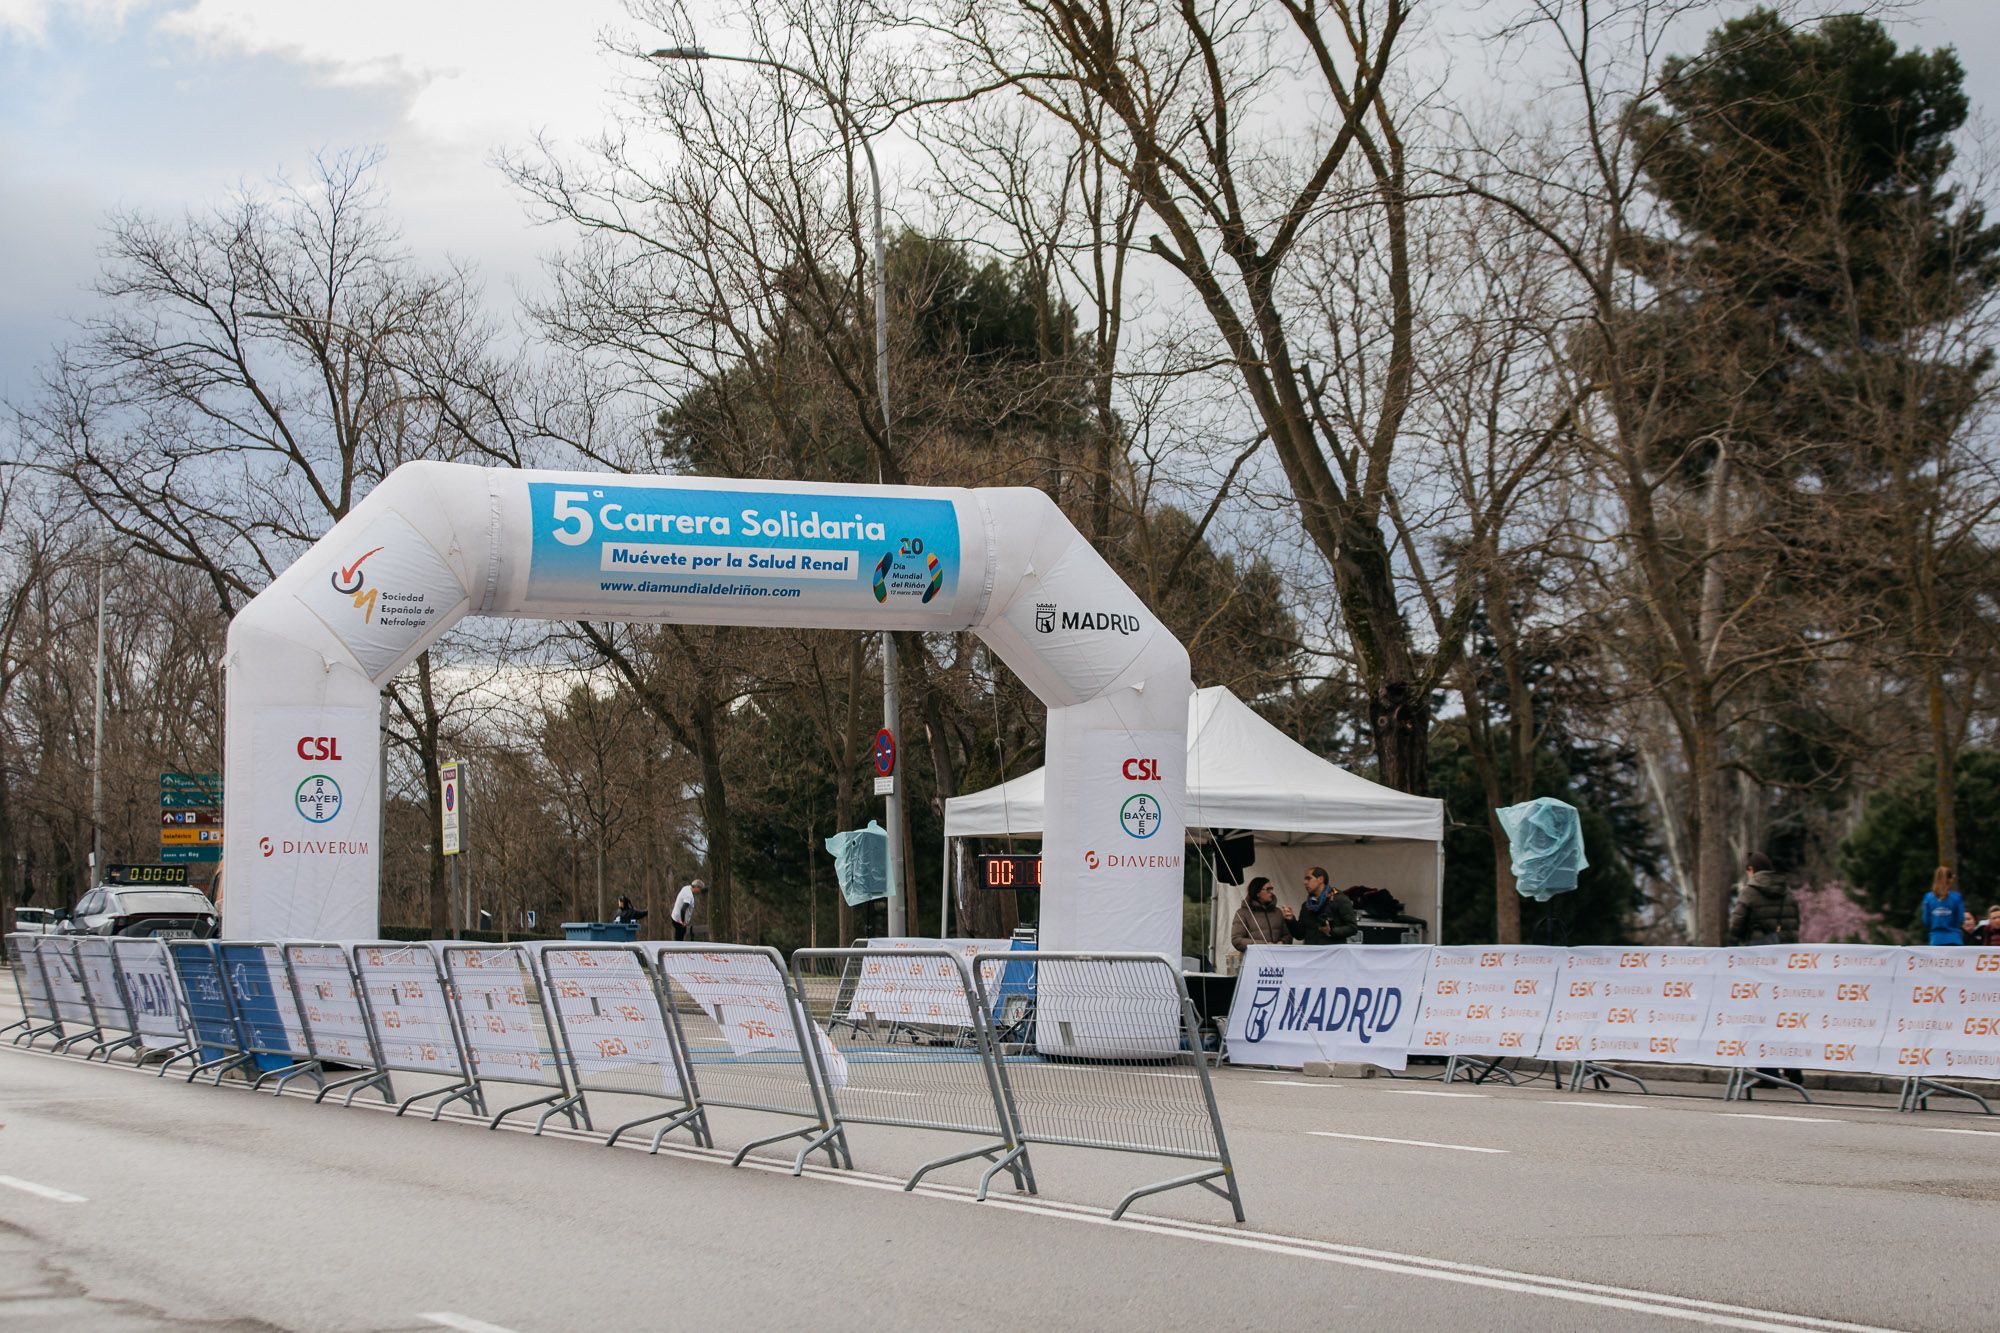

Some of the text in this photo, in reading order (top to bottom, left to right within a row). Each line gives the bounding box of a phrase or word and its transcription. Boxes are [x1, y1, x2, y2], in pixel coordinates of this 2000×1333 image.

[600, 503, 730, 535] Carrera
[741, 510, 886, 541] Solidaria
[900, 537, 924, 555] 20
[612, 549, 848, 572] Muévete por la Salud Renal
[893, 562, 906, 570] Día
[892, 572, 923, 580] Mundial
[600, 581, 801, 598] www.diamundialdelriñon.com
[904, 581, 926, 589] Riñón
[382, 592, 425, 602] Sociedad
[381, 605, 435, 615] Española de
[1062, 611, 1140, 635] MADRID
[297, 736, 342, 761] CSL
[1122, 758, 1161, 781] CSL
[300, 795, 339, 803] BAYER
[316, 779, 324, 819] BAYER
[1124, 812, 1158, 820] BAYER
[1138, 797, 1146, 835] BAYER
[283, 840, 369, 855] DIAVERUM
[1108, 854, 1180, 868] DIAVERUM
[1481, 952, 1505, 967] GSK
[1620, 952, 1650, 968] GSK
[1787, 953, 1822, 969] GSK
[1976, 954, 2000, 971] GS
[1437, 980, 1460, 994] GSK
[1514, 979, 1539, 994] GSK
[1570, 981, 1597, 997] GSK
[1663, 981, 1693, 998] GSK
[1730, 982, 1762, 999] GSK
[1837, 983, 1871, 1001] GSK
[1913, 986, 1947, 1004] GSK
[1279, 986, 1402, 1044] MADRID
[1467, 1004, 1493, 1019] GSK
[1607, 1008, 1638, 1023] GSK
[1776, 1012, 1810, 1029] GSK
[1963, 1017, 2000, 1035] GSK
[1424, 1031, 1449, 1046] GSK
[1499, 1032, 1525, 1047] GSK
[1555, 1035, 1583, 1051] GSK
[1649, 1037, 1679, 1053] GSK
[1716, 1040, 1749, 1056] GSK
[1823, 1043, 1857, 1061] GSK
[1898, 1048, 1934, 1065] GSK
